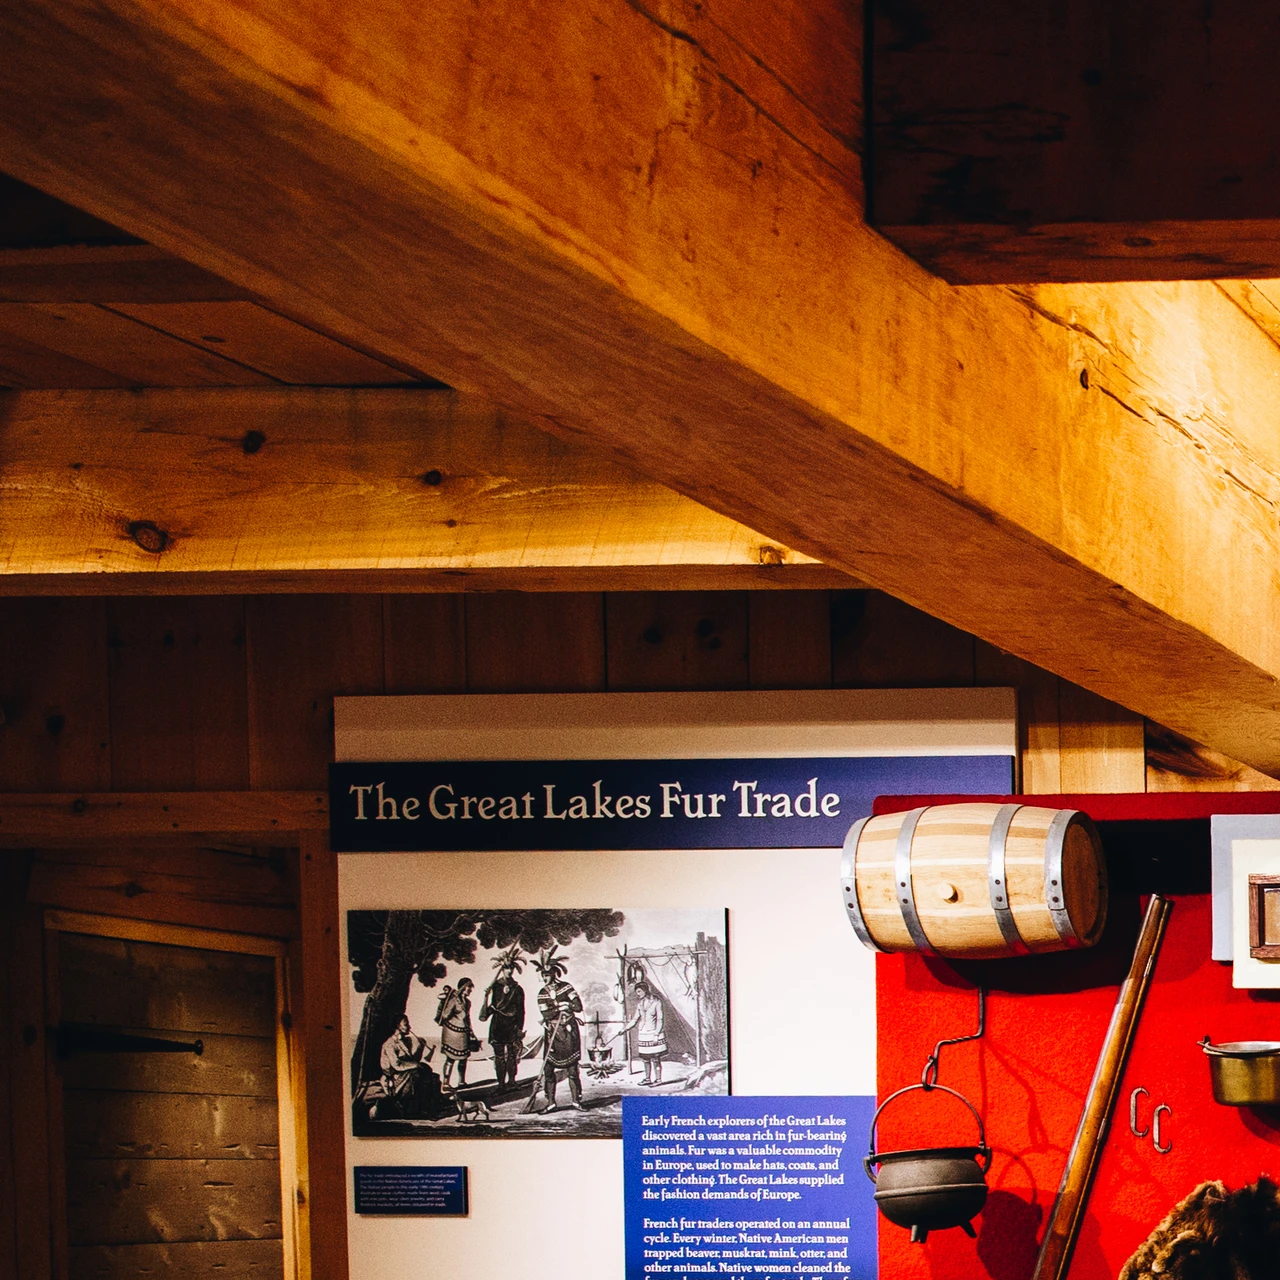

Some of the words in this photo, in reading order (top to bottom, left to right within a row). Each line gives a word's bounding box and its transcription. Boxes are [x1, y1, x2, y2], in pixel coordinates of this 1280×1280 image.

[350, 782, 419, 820] The
[429, 784, 535, 820] Great
[543, 780, 651, 820] Lakes
[659, 781, 726, 819] Fur
[733, 777, 840, 817] Trade
[642, 1115, 670, 1128] Early
[671, 1115, 706, 1126] French
[707, 1114, 756, 1129] explorers
[756, 1114, 769, 1128] of
[768, 1114, 786, 1126] the
[786, 1115, 816, 1126] Great
[816, 1114, 846, 1126] Lakes
[642, 1129, 697, 1141] discovered
[706, 1132, 727, 1140] vast
[728, 1133, 751, 1141] area
[752, 1129, 774, 1141] rich
[774, 1130, 786, 1140] in
[787, 1129, 847, 1143] fur-bearing
[642, 1144, 687, 1155] animals.
[688, 1145, 706, 1155] Fur
[736, 1144, 782, 1156] valuable
[782, 1144, 843, 1158] commodity
[642, 1160, 653, 1170] in
[655, 1159, 694, 1172] Europe,
[696, 1159, 719, 1170] used
[720, 1161, 732, 1170] to
[732, 1158, 762, 1170] make
[762, 1158, 787, 1171] hats,
[788, 1161, 818, 1171] coats,
[818, 1158, 839, 1170] and
[642, 1174, 671, 1185] other
[672, 1173, 717, 1187] clothing.
[718, 1173, 738, 1185] The
[738, 1174, 768, 1185] Great
[769, 1173, 799, 1185] Lakes
[799, 1173, 844, 1187] supplied
[643, 1188, 660, 1199] the
[661, 1188, 700, 1201] fashion
[701, 1188, 749, 1199] demands
[750, 1187, 762, 1202] of
[761, 1188, 802, 1202] Europe.
